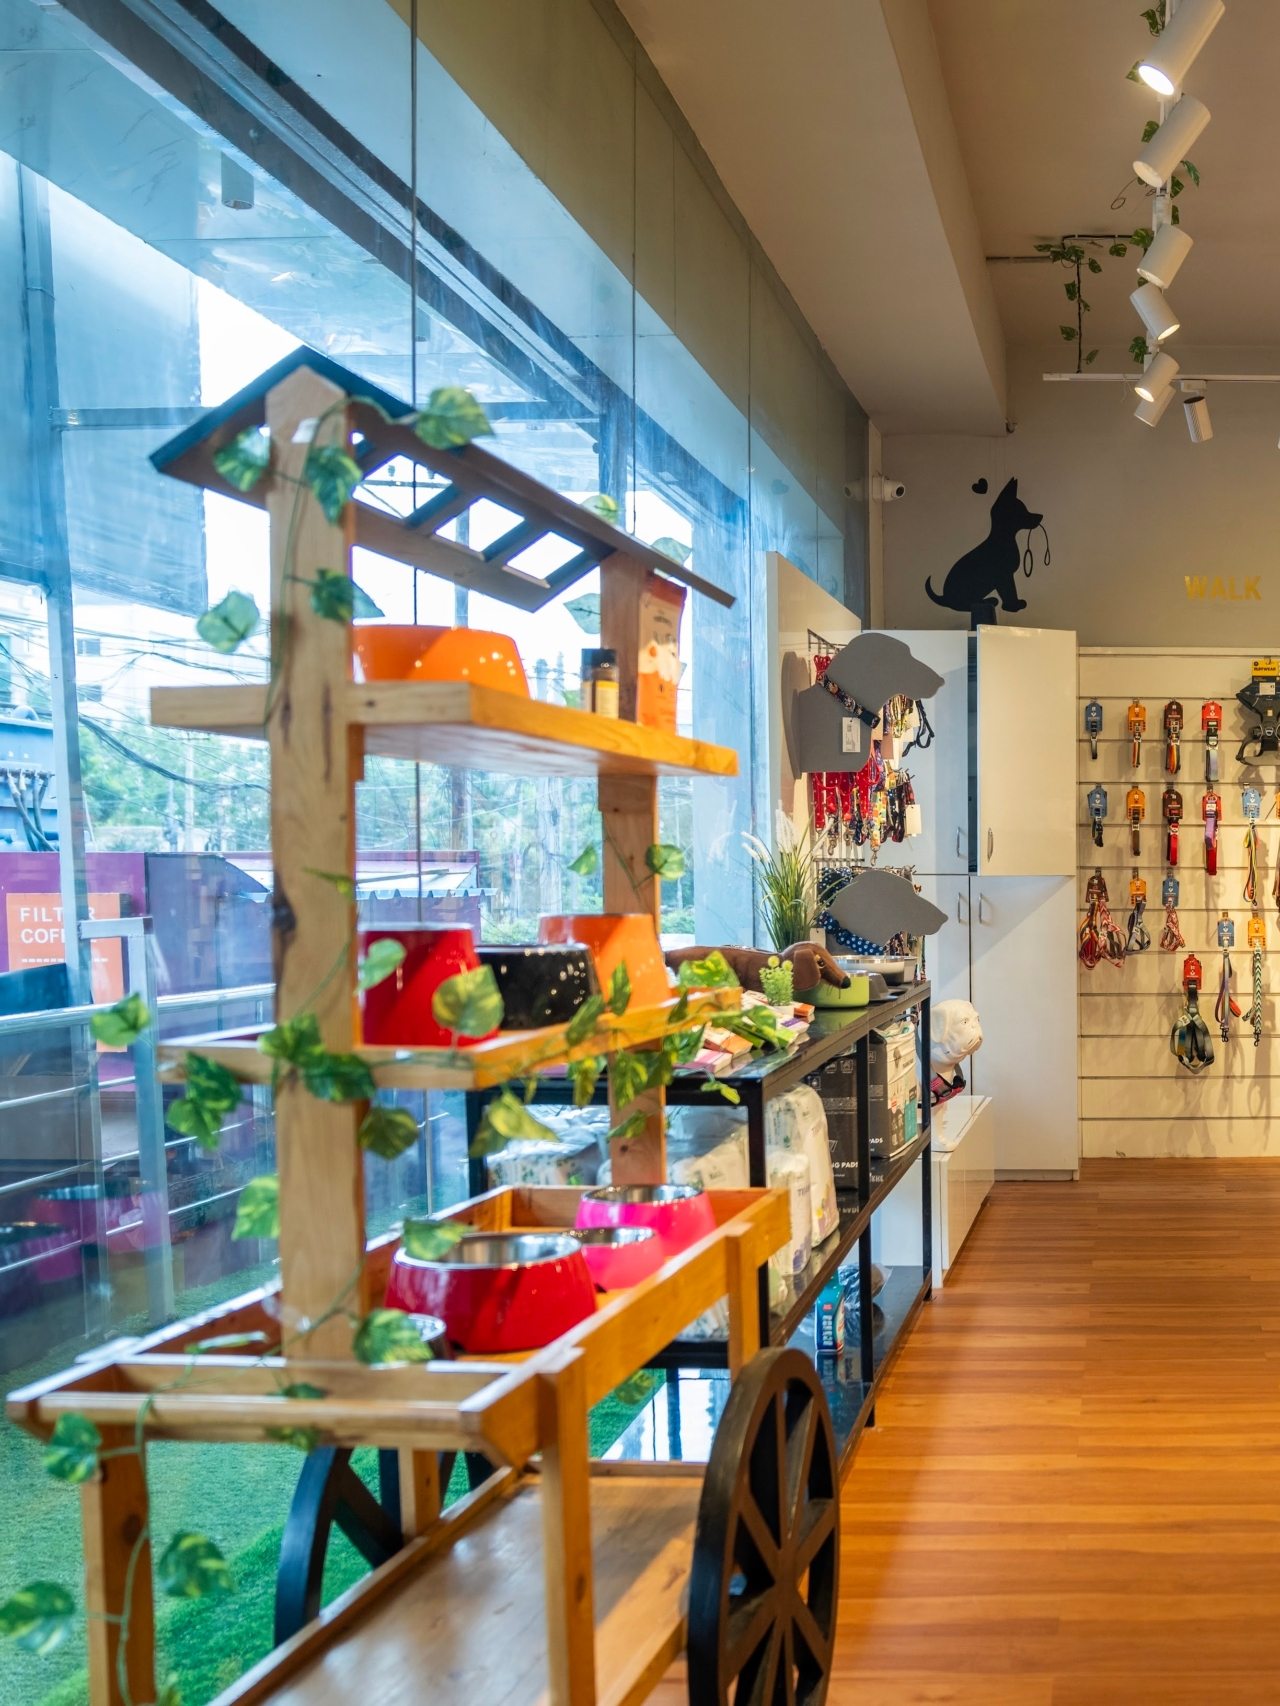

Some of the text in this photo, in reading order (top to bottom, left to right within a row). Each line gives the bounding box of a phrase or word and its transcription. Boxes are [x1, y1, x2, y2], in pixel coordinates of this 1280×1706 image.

[1185, 575, 1262, 600] WALK
[20, 907, 96, 922] FILTR
[21, 928, 97, 944] COF
